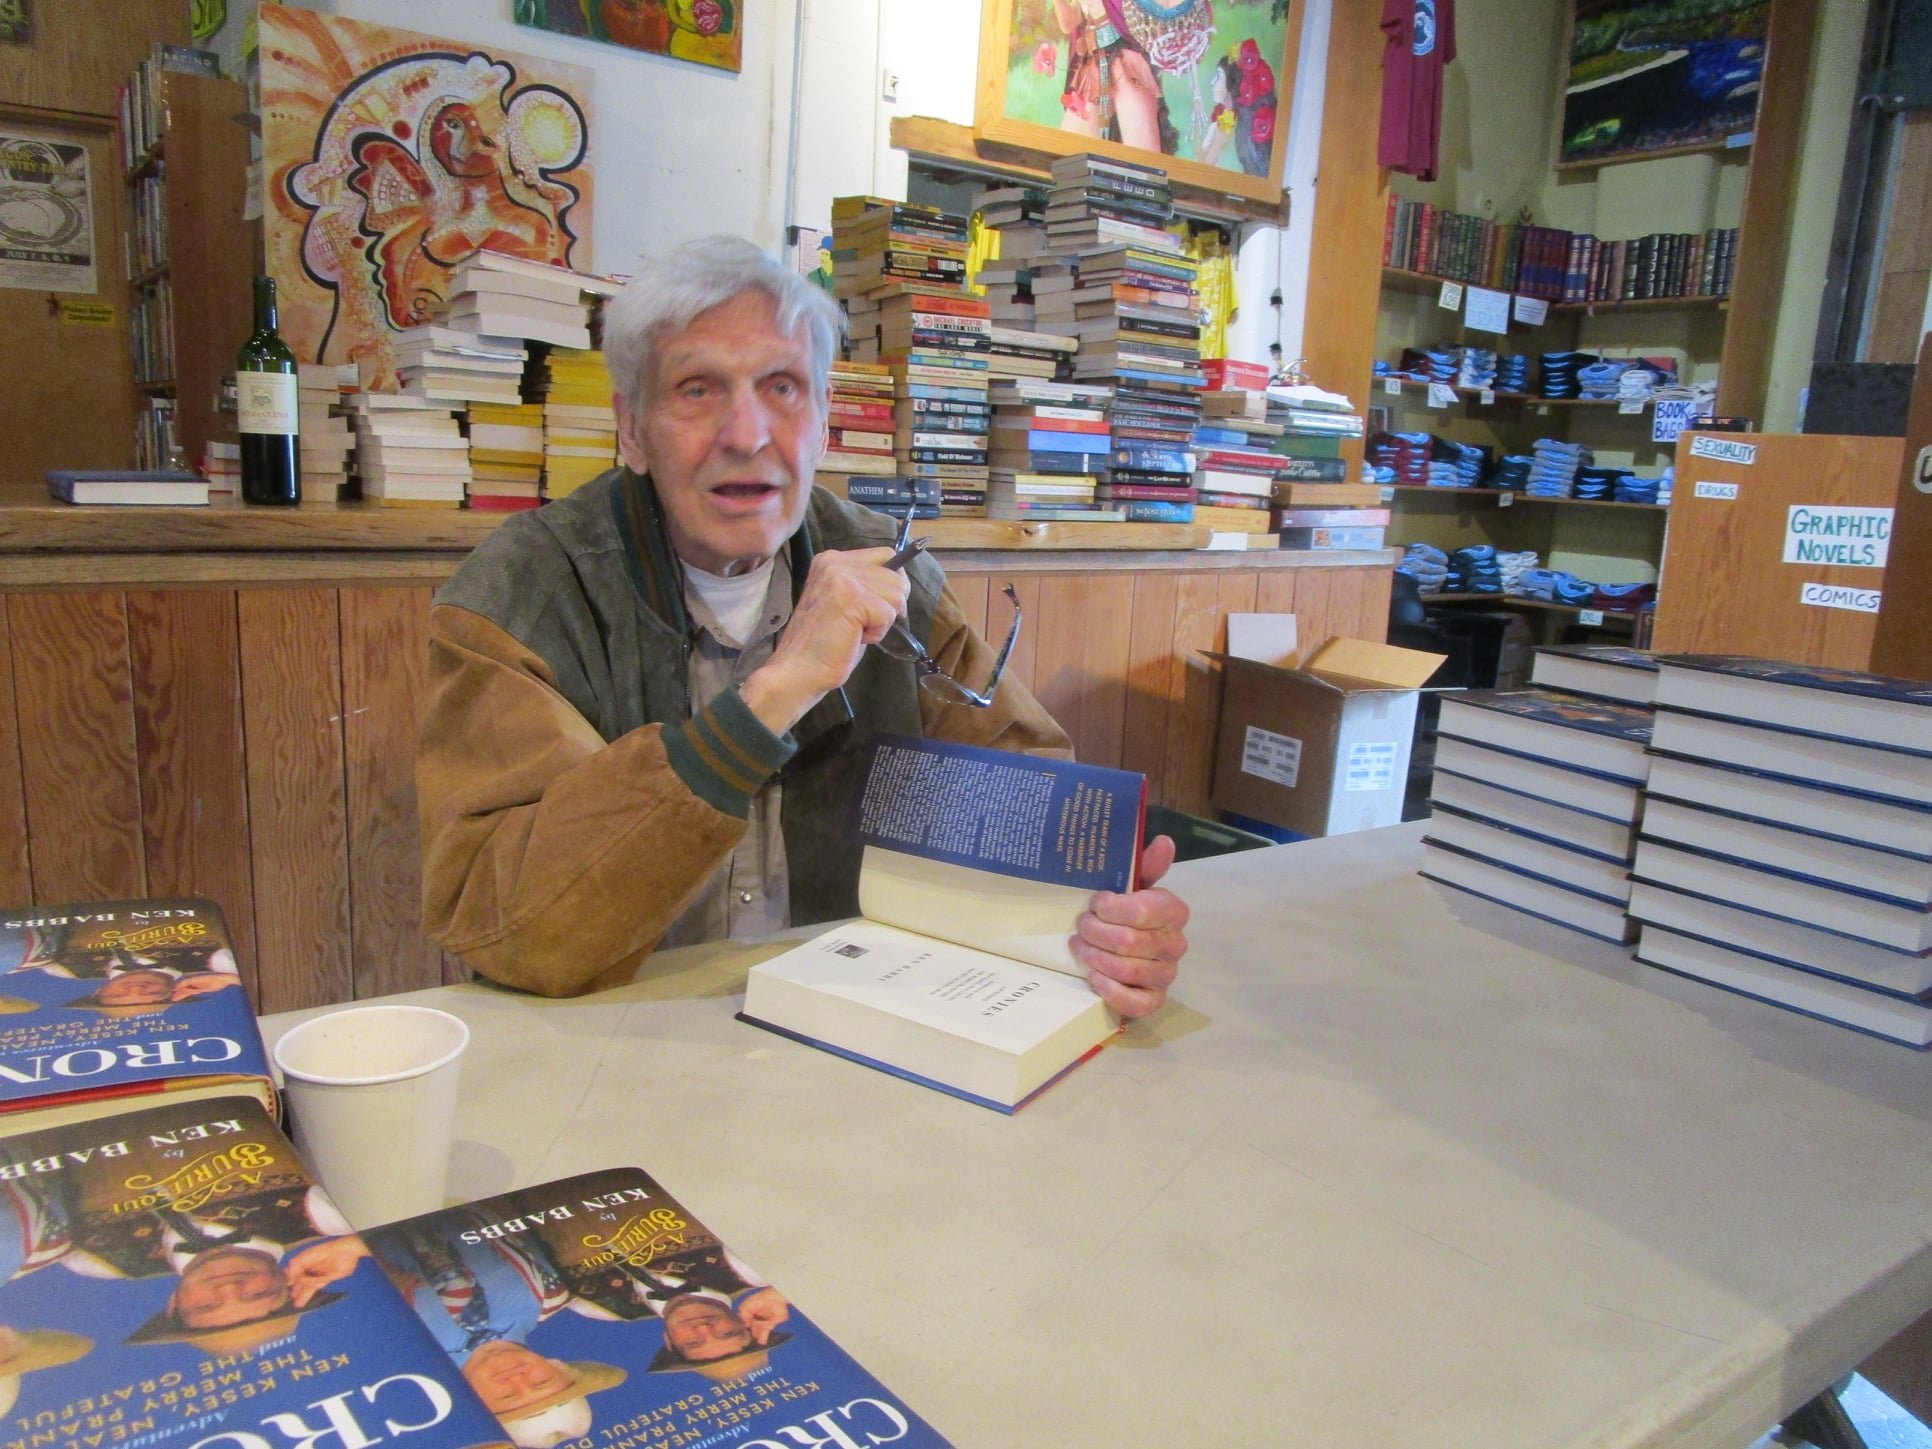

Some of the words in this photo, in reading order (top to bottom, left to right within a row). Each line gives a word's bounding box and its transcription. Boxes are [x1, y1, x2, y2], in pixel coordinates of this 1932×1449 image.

[1112, 181, 1155, 197] FEED
[1656, 402, 1690, 419] BOOK
[1694, 437, 1756, 461] SEXUALITY
[850, 486, 884, 496] ANATHEM
[1698, 486, 1736, 498] DRUGS
[1791, 509, 1889, 540] GRAPHIC
[1797, 539, 1876, 566] NOVELS
[1806, 587, 1880, 609] COMICS
[1059, 797, 1070, 834] MYSTERIOUS
[1104, 798, 1112, 818] BULLET
[1070, 813, 1078, 835] THINGS
[5, 914, 115, 929] BABBS
[131, 909, 195, 919] KEN
[178, 936, 192, 944] A
[980, 981, 1040, 1018] CRONIES
[54, 1023, 118, 1037] MERRY
[95, 1017, 129, 1025] THE
[131, 1019, 166, 1028] THE
[149, 1023, 188, 1033] KEN
[149, 1120, 244, 1148] KEN
[162, 1149, 184, 1159] by
[240, 1171, 260, 1185] A
[582, 1188, 652, 1212] KEN
[460, 1205, 576, 1246] BABBS
[600, 1211, 617, 1222] by
[667, 1233, 685, 1245] A
[253, 1334, 297, 1355] and
[196, 1350, 254, 1377] THE
[257, 1348, 312, 1375] THE
[291, 1352, 349, 1382] KEN
[748, 1365, 773, 1382] and
[142, 1370, 242, 1412] MERRY
[171, 1377, 275, 1417] KESEY,
[710, 1377, 748, 1397] THE
[753, 1377, 792, 1397] THE
[780, 1381, 820, 1401] KEN
[17, 1370, 182, 1430] GRATEFUL
[686, 1394, 747, 1424] MERRY
[183, 1373, 452, 1449] CR
[599, 1394, 703, 1440] GRATEFUL
[707, 1399, 776, 1428] KESEY,
